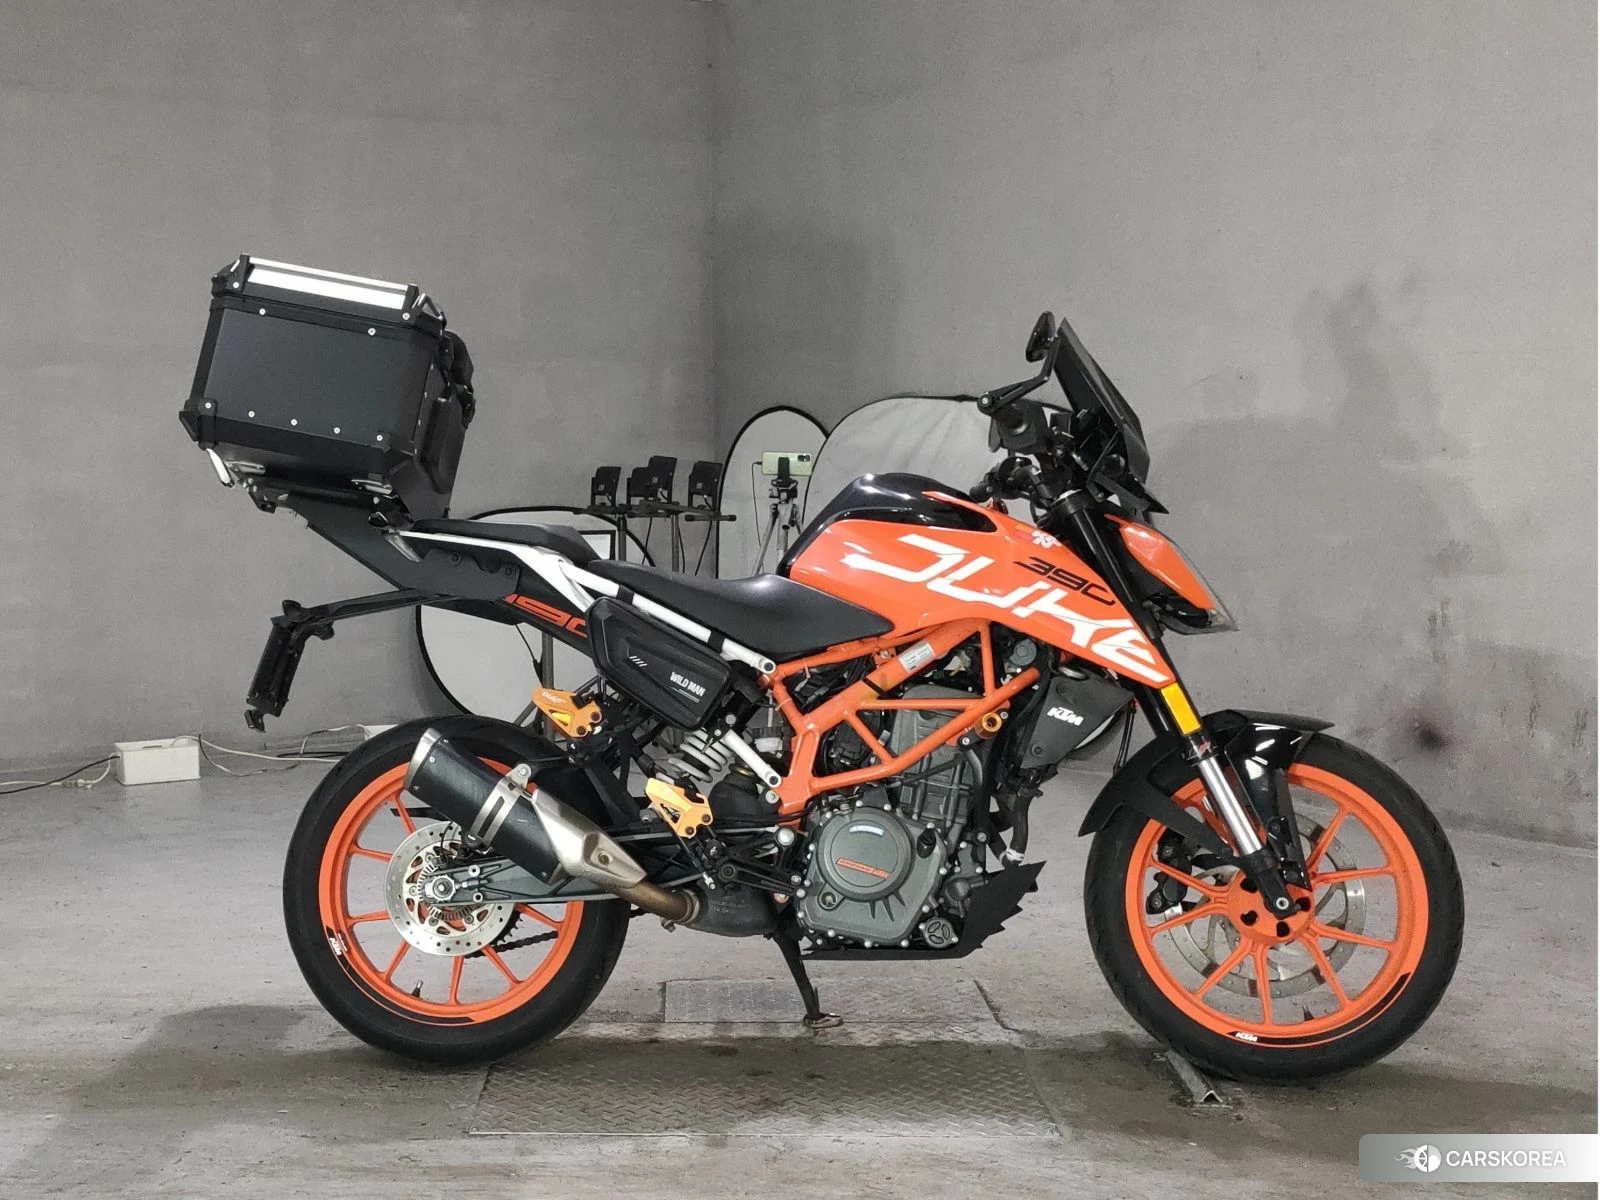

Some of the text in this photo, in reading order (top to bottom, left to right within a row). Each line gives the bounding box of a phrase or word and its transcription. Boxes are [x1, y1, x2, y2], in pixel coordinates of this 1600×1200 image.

[1013, 556, 1116, 606] 390
[503, 593, 588, 638] 90
[670, 671, 690, 688] WILD
[687, 681, 706, 697] MAN
[1047, 706, 1084, 726] KTM
